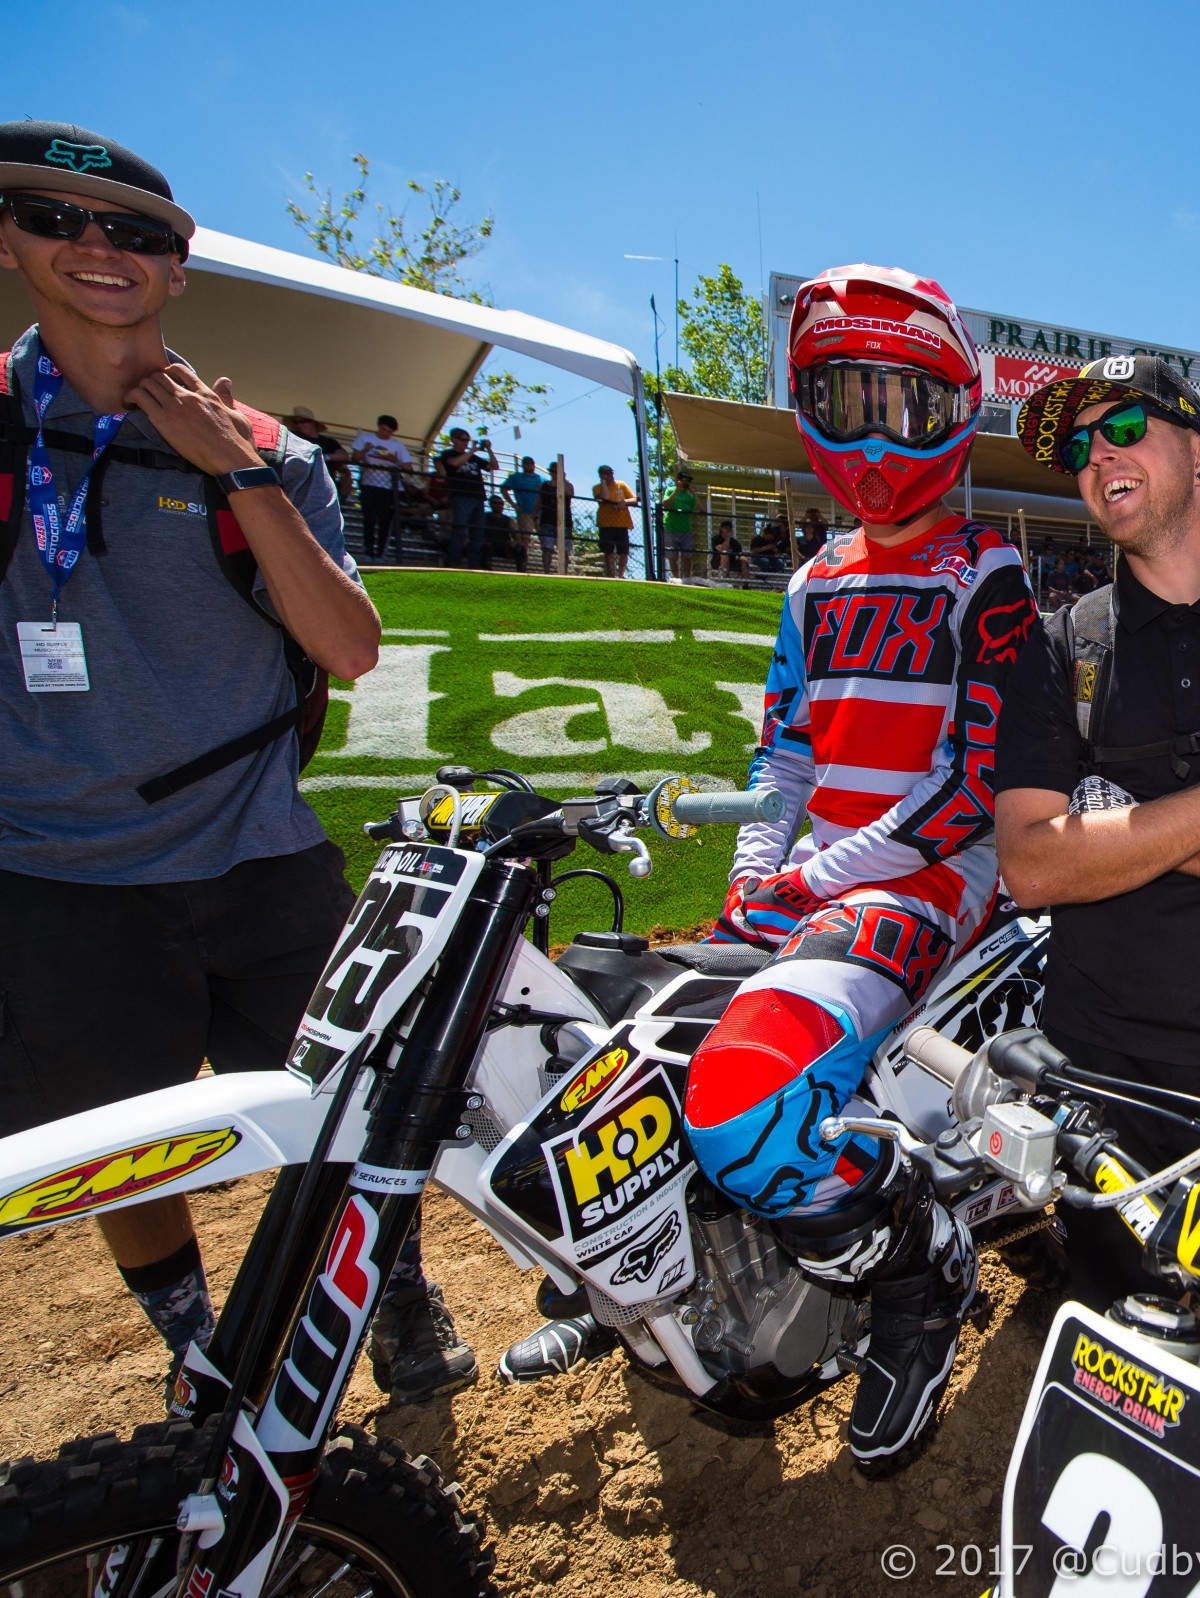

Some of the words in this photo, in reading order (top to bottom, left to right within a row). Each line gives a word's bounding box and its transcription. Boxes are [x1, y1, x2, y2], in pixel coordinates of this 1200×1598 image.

[814, 314, 941, 349] MOSIMAN
[865, 340, 882, 350] FOX
[989, 319, 1112, 360] PRAIRIE
[805, 593, 948, 675] FOX
[398, 851, 423, 873] OIL
[775, 885, 820, 914] FOX
[775, 904, 949, 1001] FOX
[891, 1003, 928, 1036] TWISTED
[563, 1048, 625, 1113] FMF
[0, 1126, 235, 1226] FMF
[358, 1172, 408, 1187] SERVICES
[581, 1138, 681, 1228] SUPPLY
[573, 1204, 649, 1253] CONSTRUCTION
[656, 1163, 697, 1203] INDUSTRIAL
[576, 1239, 613, 1260] WHITE
[613, 1225, 635, 1242] CAP
[1073, 1335, 1184, 1422] ROCKSTAR
[1075, 1367, 1122, 1406] ENERGY
[1122, 1396, 1166, 1434] DRINK
